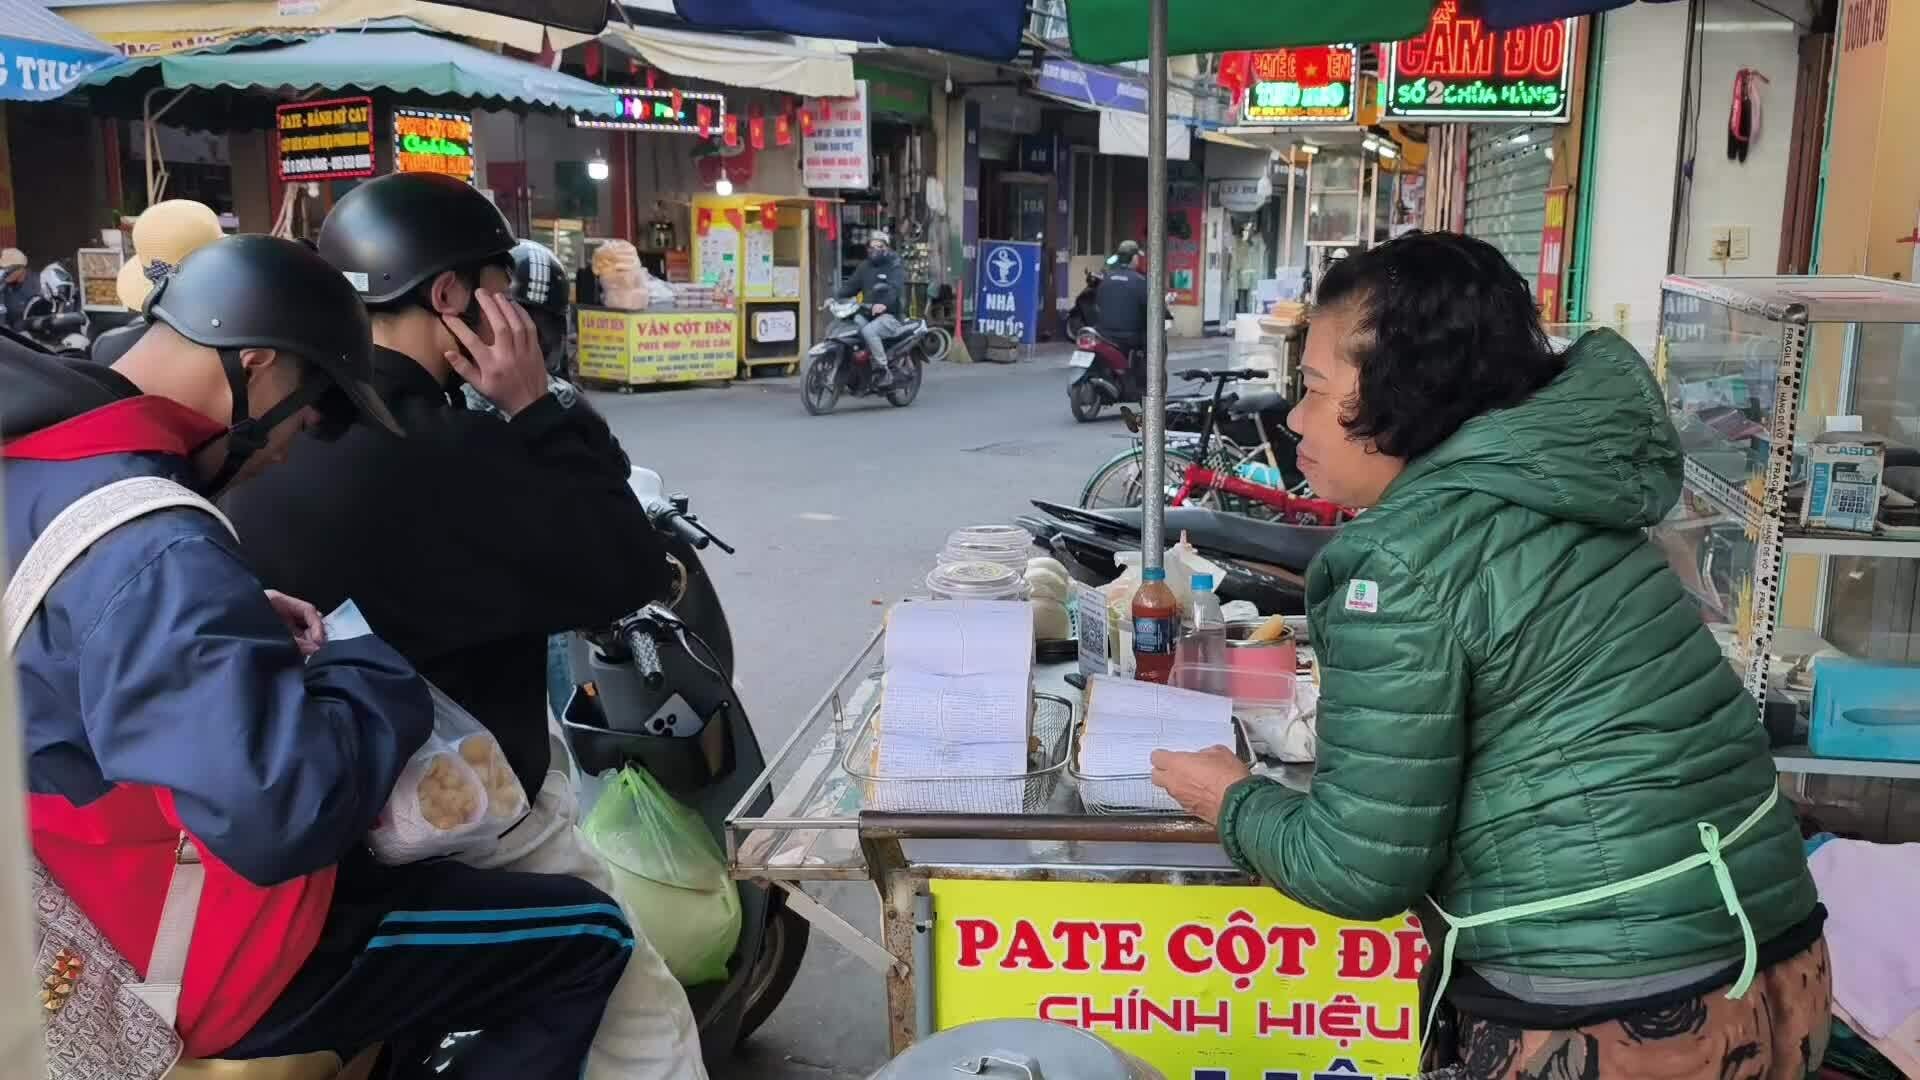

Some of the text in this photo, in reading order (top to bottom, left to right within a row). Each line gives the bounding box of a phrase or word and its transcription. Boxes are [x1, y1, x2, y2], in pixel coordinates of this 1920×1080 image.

[1398, 77, 1557, 104] SỐ 2 CHÙA HÀNG
[986, 291, 1015, 311] NHÀ
[1783, 327, 1793, 367] FRAGILE
[1826, 447, 1876, 457] CASIO
[957, 920, 1146, 972] PATE
[1168, 910, 1316, 989] CỘT
[1039, 990, 1409, 1047] CHÍNH HIỆU
